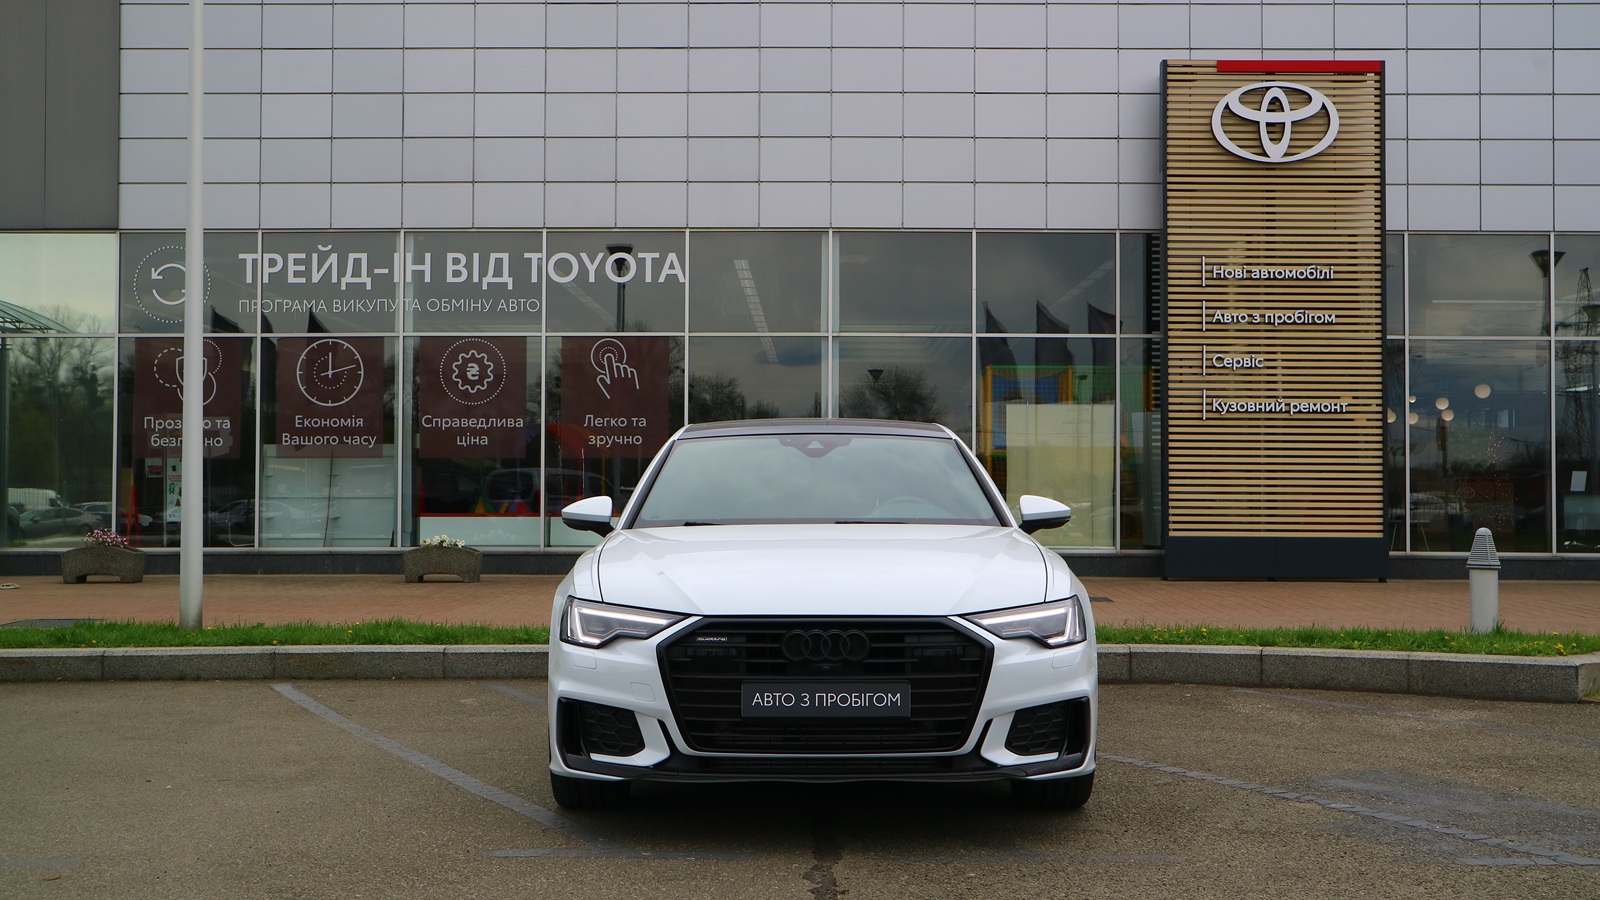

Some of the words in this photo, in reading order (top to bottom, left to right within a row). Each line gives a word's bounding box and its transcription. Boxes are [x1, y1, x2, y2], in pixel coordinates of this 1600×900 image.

[238, 244, 431, 291] ТРЕЙД-ІН
[446, 252, 513, 290] ВІД
[524, 251, 685, 283] TOYOTA
[1213, 265, 1247, 279] Нові
[1251, 265, 1334, 280] автомобілі
[239, 299, 328, 313] ПРОГРАМА
[333, 299, 398, 312] ВИКУПУ
[402, 299, 422, 312] ТА
[426, 298, 493, 312] ОБМІНУ
[497, 298, 540, 312] АВТО
[1213, 310, 1248, 324] Авто
[1252, 315, 1261, 324] з
[1265, 310, 1336, 327] пробігом
[1212, 354, 1264, 370] Сервіс
[1212, 398, 1286, 415] Кузовний
[1290, 403, 1348, 415] ремонт
[143, 416, 212, 432] Прозо
[215, 419, 231, 429] та
[295, 414, 364, 428] Економія
[421, 414, 524, 429] Справедлива
[583, 414, 627, 428] Легко
[631, 417, 647, 428] та
[282, 433, 339, 446] Вашого
[343, 436, 377, 447] часу
[456, 433, 488, 448] ціна
[588, 434, 642, 447] зручно
[752, 693, 795, 707] АВТО
[815, 693, 901, 707] ПРОБІГОМ
